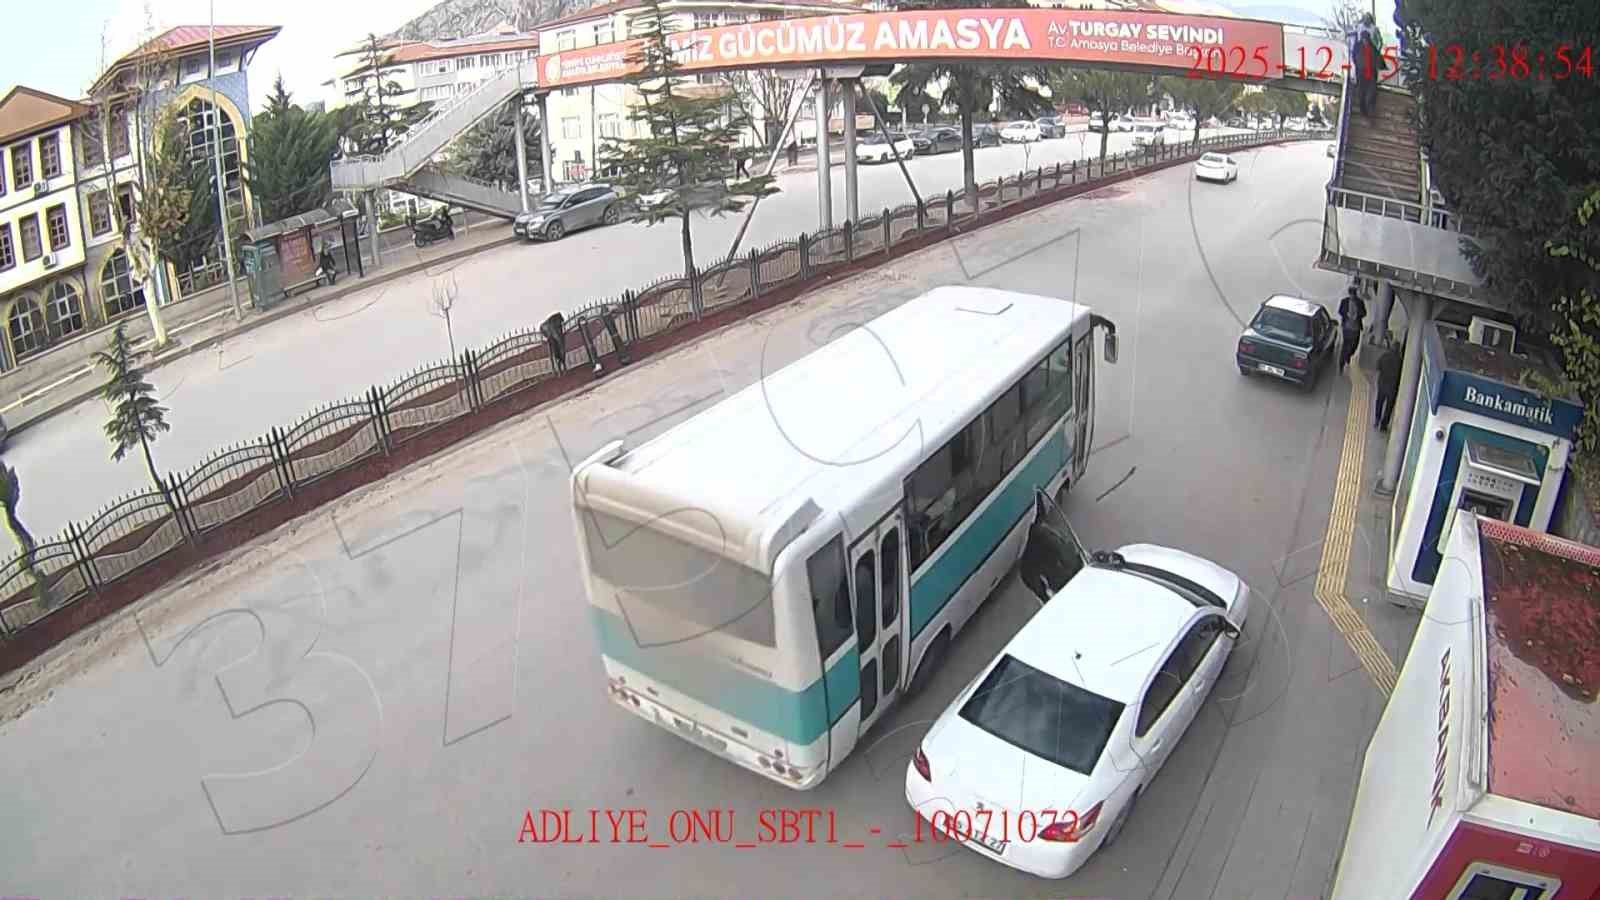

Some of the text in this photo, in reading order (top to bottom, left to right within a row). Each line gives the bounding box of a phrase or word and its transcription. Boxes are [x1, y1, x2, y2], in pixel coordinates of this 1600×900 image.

[718, 16, 866, 59] GÜCÜMÜZ
[874, 18, 1032, 50] AMASYA
[1069, 20, 1142, 39] TURGAY
[1147, 25, 1224, 45] SEVİNDİ
[1070, 38, 1119, 53] Amasya
[1121, 40, 1173, 57] Belediye
[1464, 385, 1554, 425] Bankamatik
